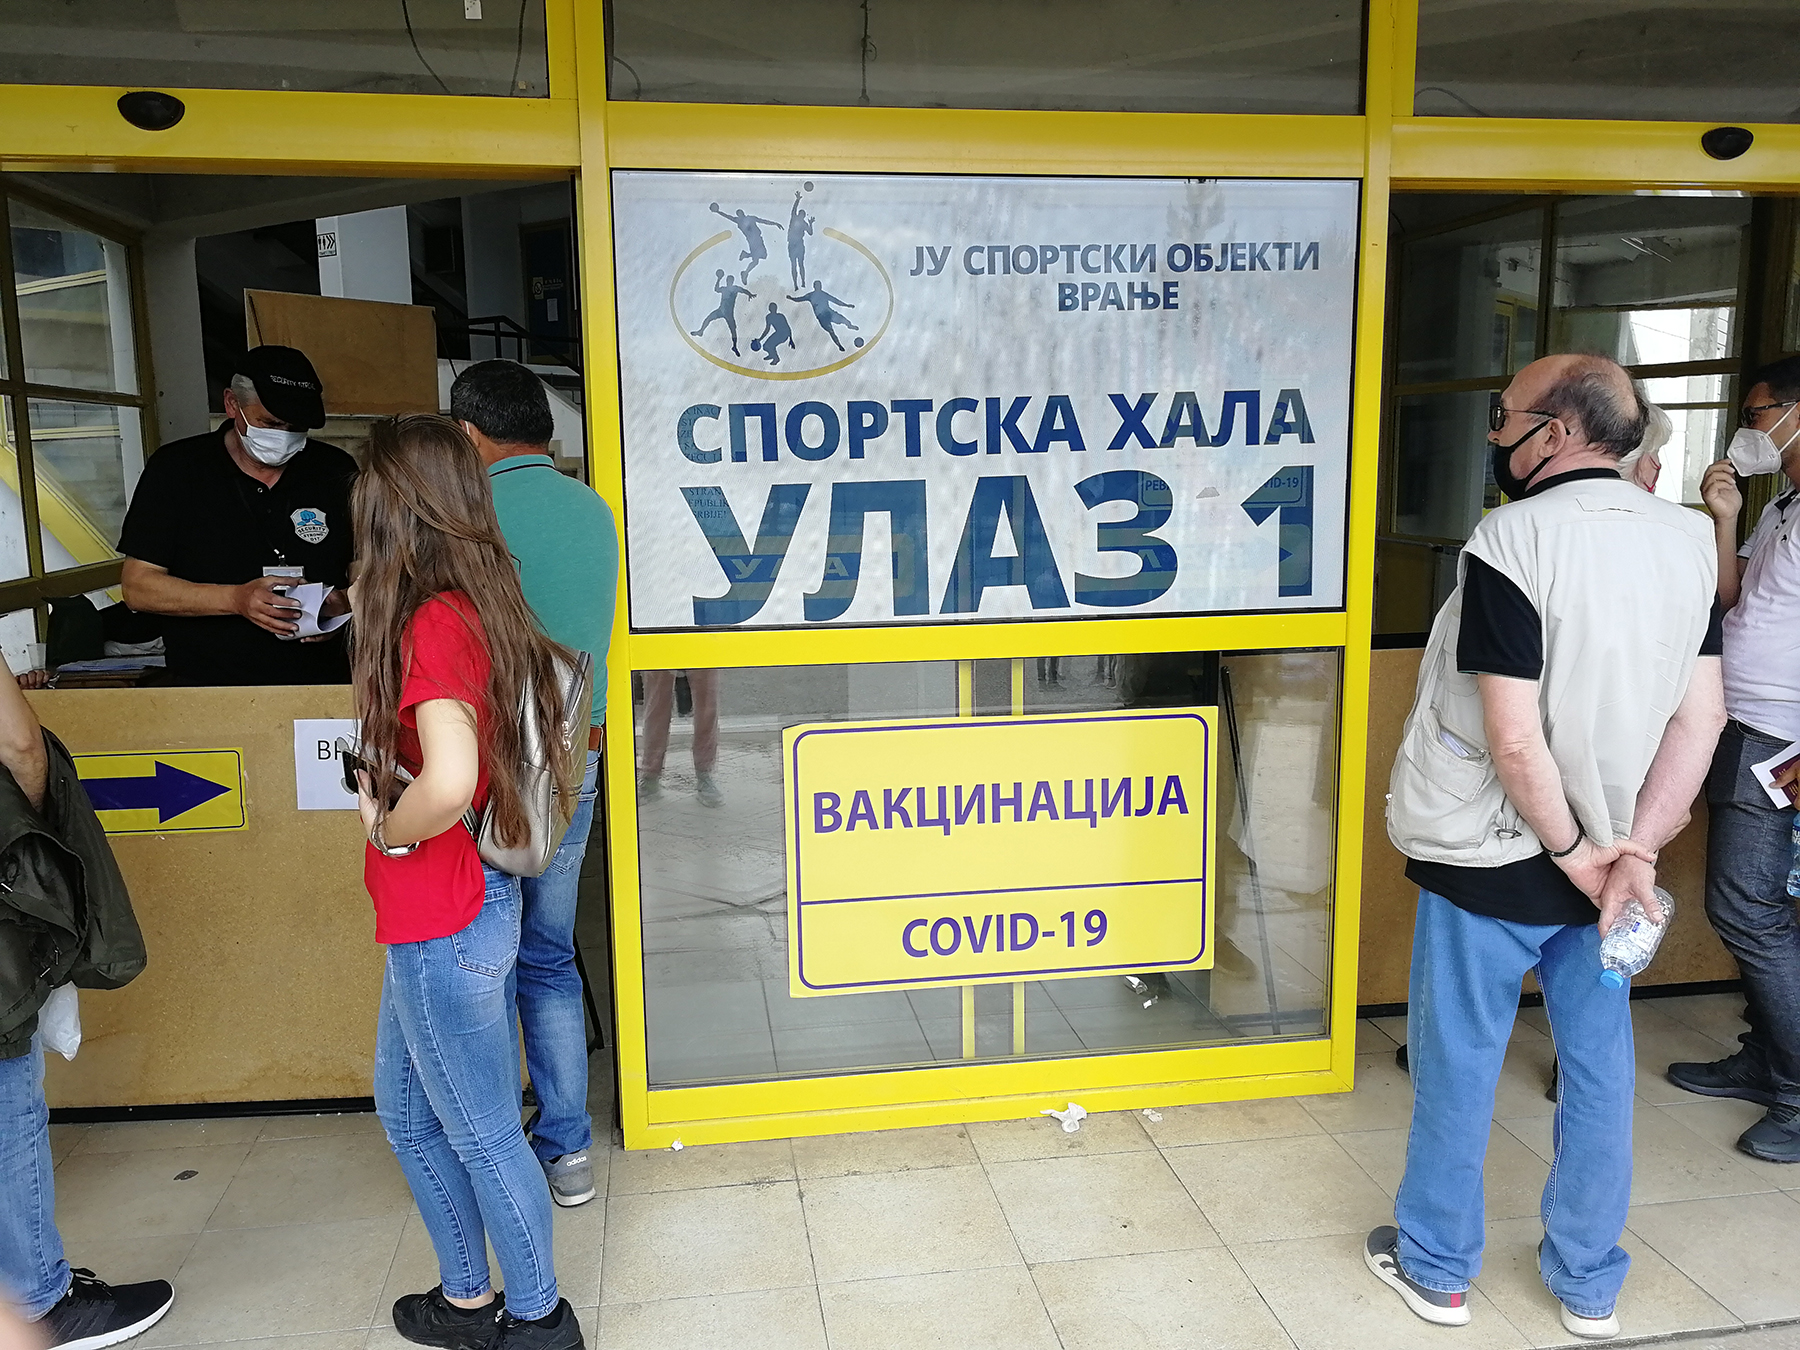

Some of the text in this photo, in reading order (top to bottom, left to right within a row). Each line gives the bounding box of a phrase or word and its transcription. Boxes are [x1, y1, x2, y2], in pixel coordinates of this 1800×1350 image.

[910, 241, 1320, 276] ЈУ СПОРТСКИ ОБЈЕКТИ
[1057, 281, 1180, 312] ВРАЊЕ
[677, 394, 1086, 464] СПОРТСКА
[1107, 388, 1316, 450] ХАЛА
[678, 465, 1314, 626] УЛАЗ 1
[813, 774, 1189, 836] ВАКЦИНАЦИЈА
[901, 908, 1108, 958] COVID-19
[567, 1155, 588, 1167] adidas
